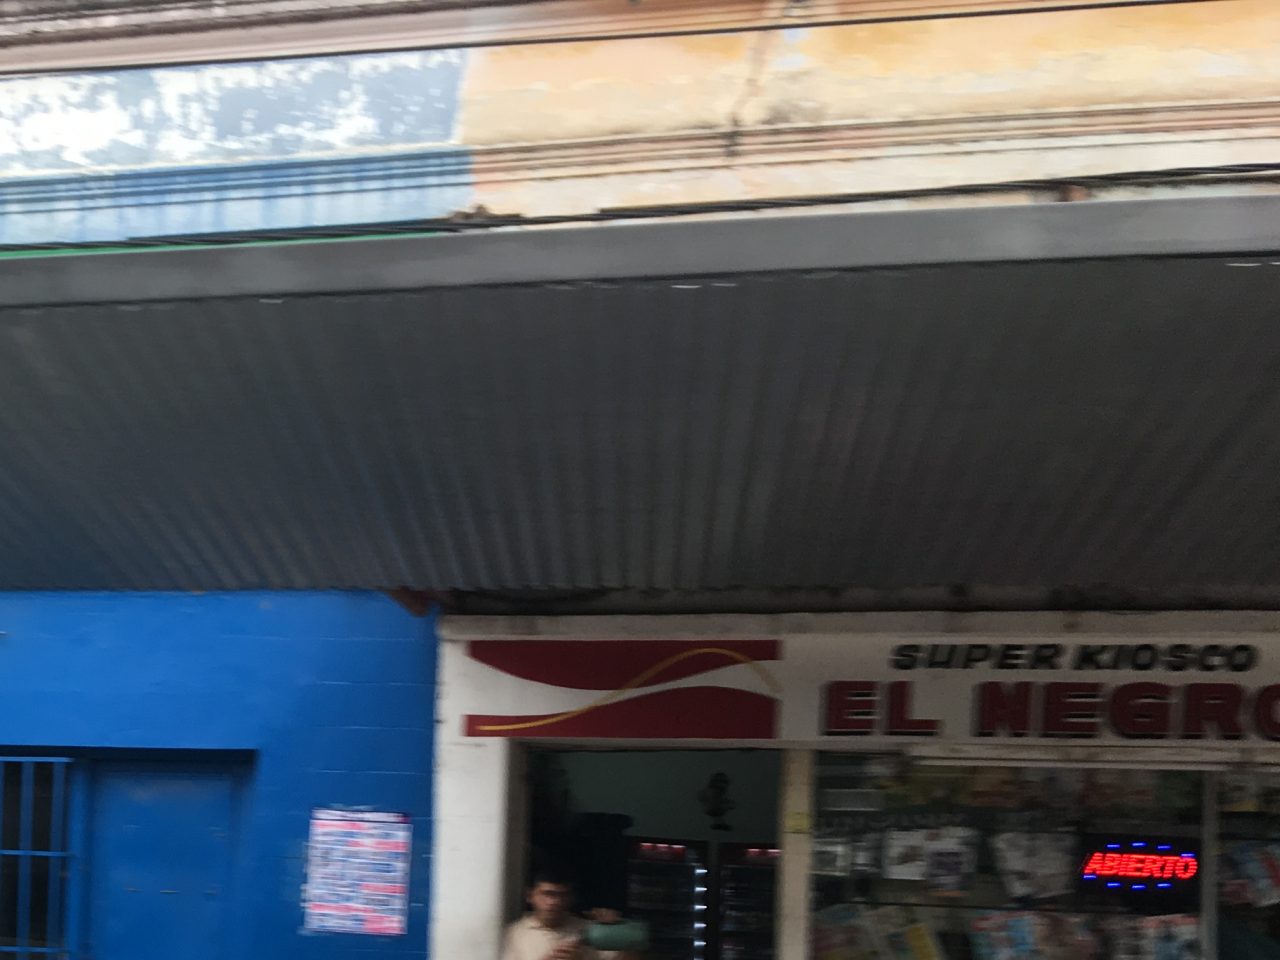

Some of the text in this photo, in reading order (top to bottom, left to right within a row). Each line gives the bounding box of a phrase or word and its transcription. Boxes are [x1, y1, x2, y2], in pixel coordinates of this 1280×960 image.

[889, 643, 1259, 672] SUPER KIOSCO
[821, 680, 942, 736] EL
[1083, 851, 1199, 879] ABIERTO
